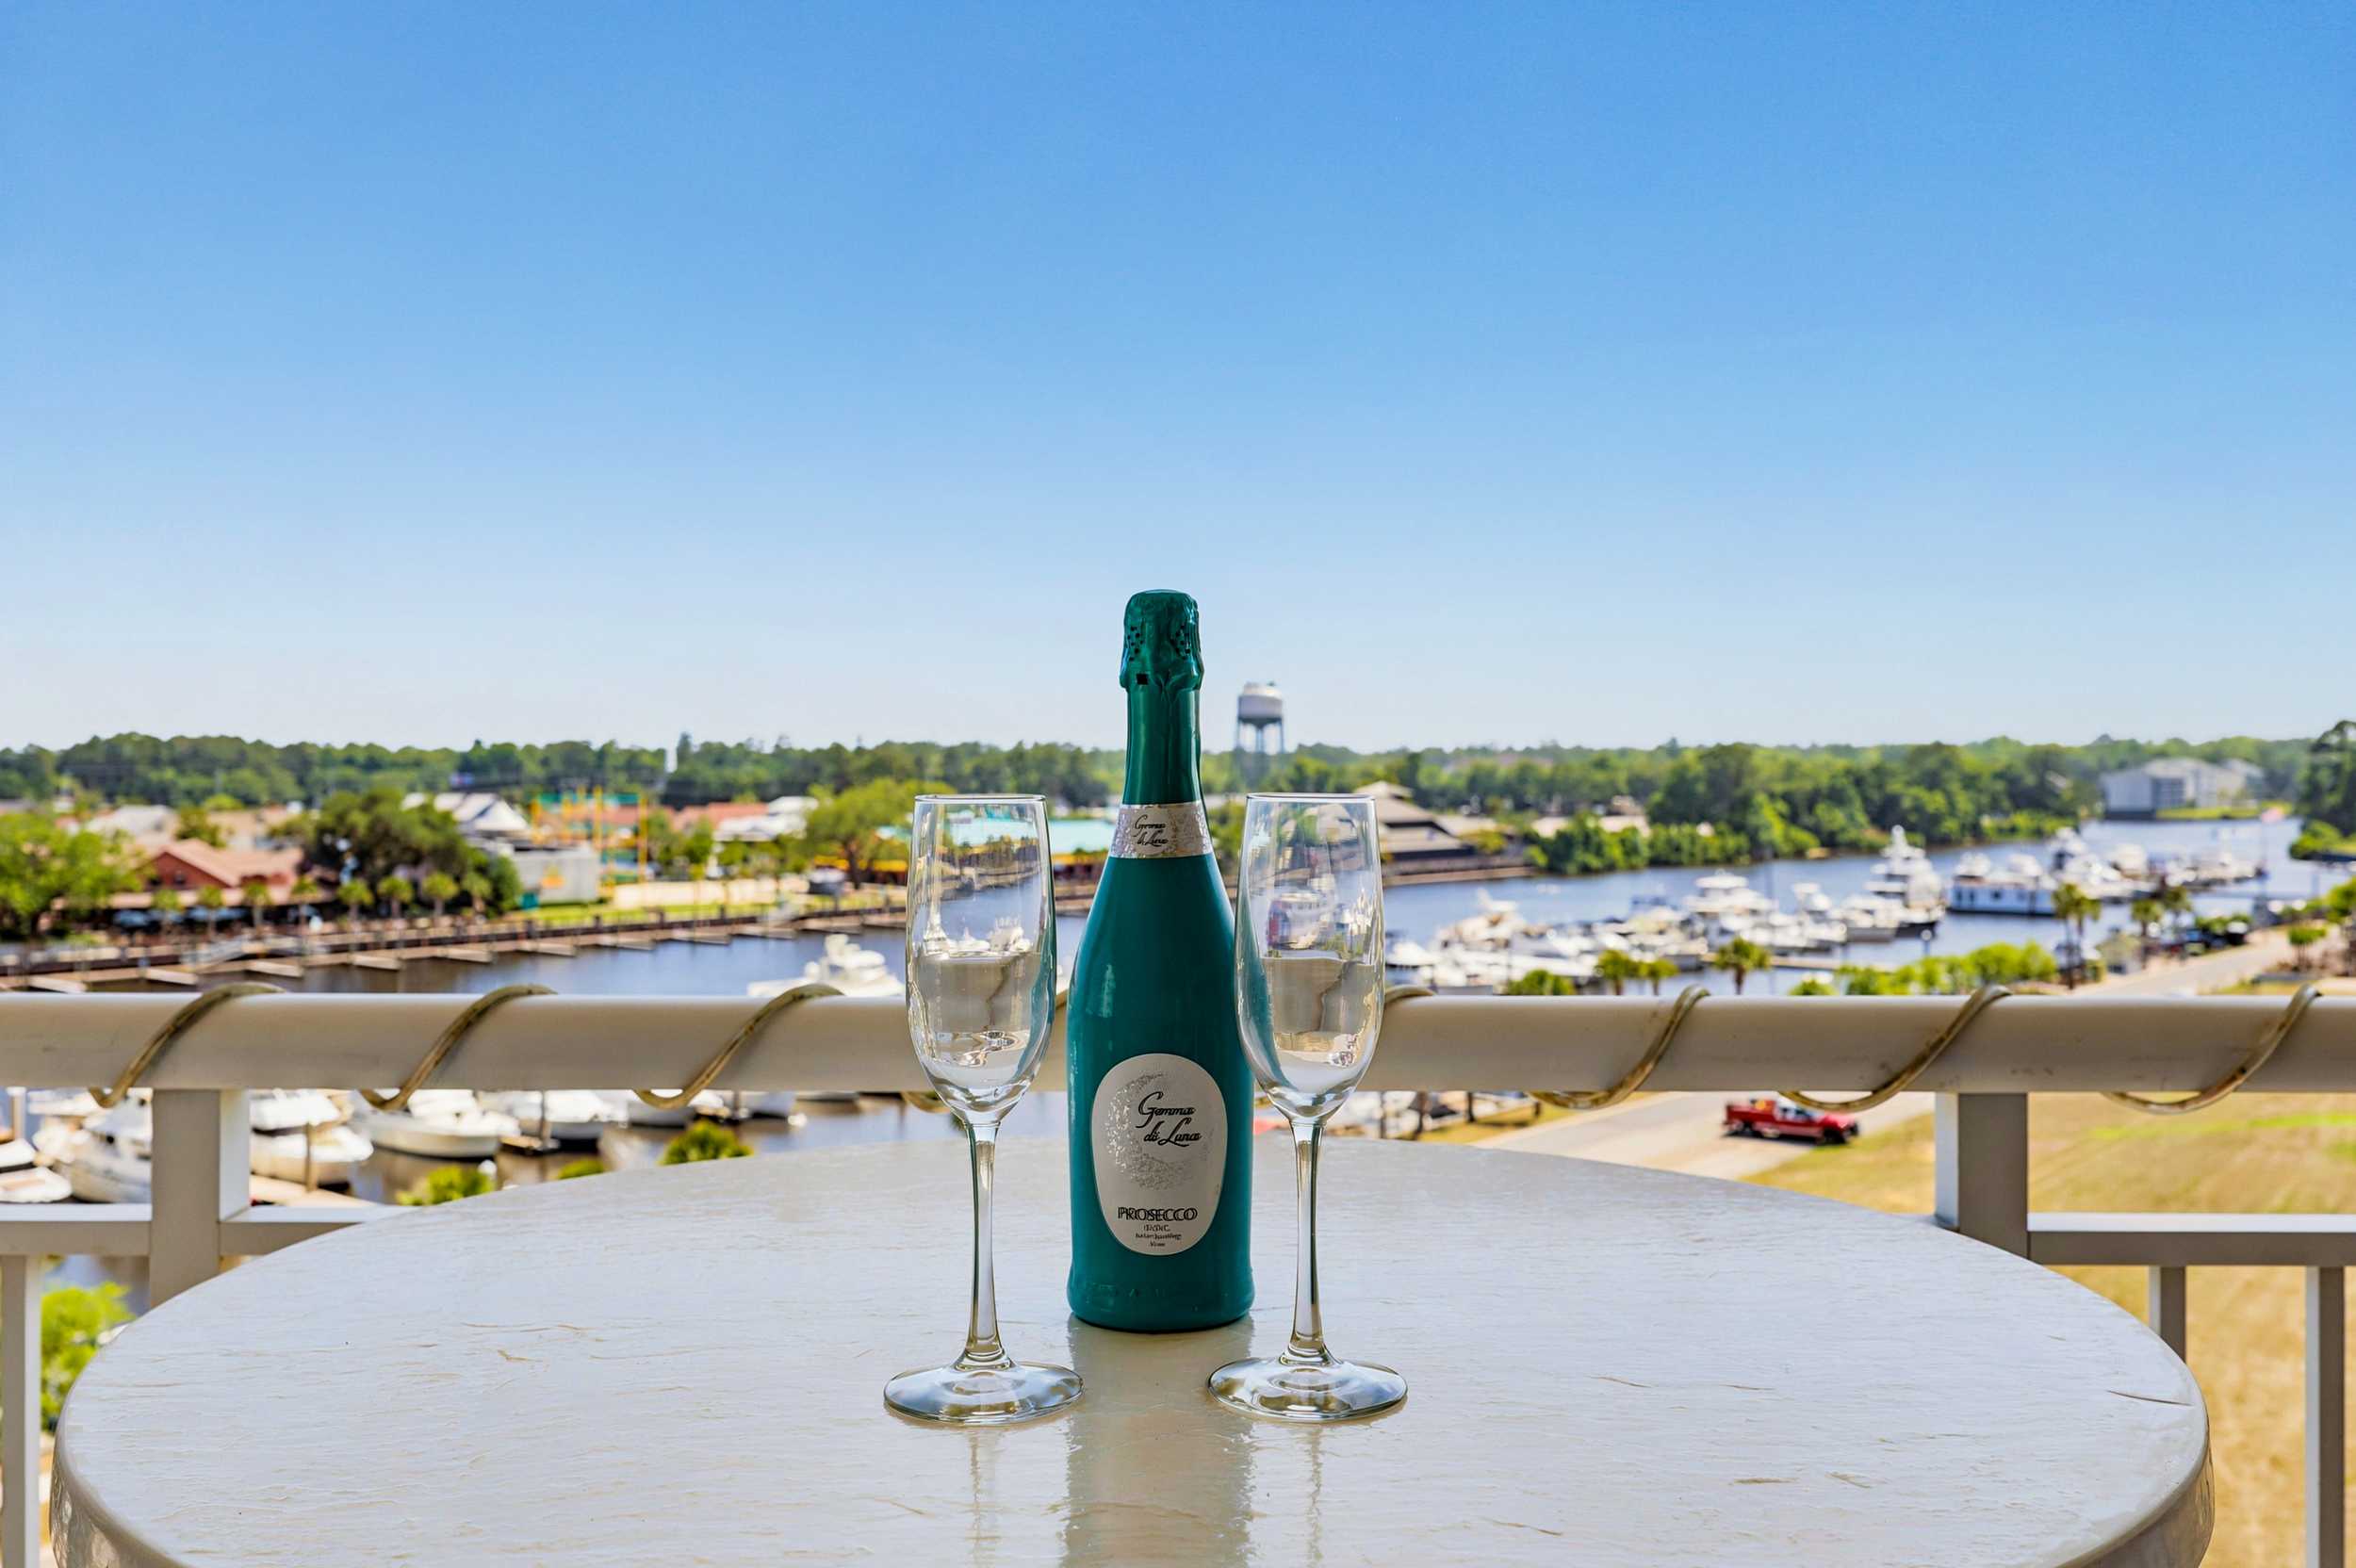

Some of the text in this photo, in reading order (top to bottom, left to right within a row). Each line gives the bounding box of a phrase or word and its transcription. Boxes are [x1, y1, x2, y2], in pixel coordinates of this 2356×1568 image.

[1136, 1091, 1195, 1129] Gemma
[1157, 1117, 1203, 1148] Luna
[1118, 1206, 1198, 1221] PROSECCO
